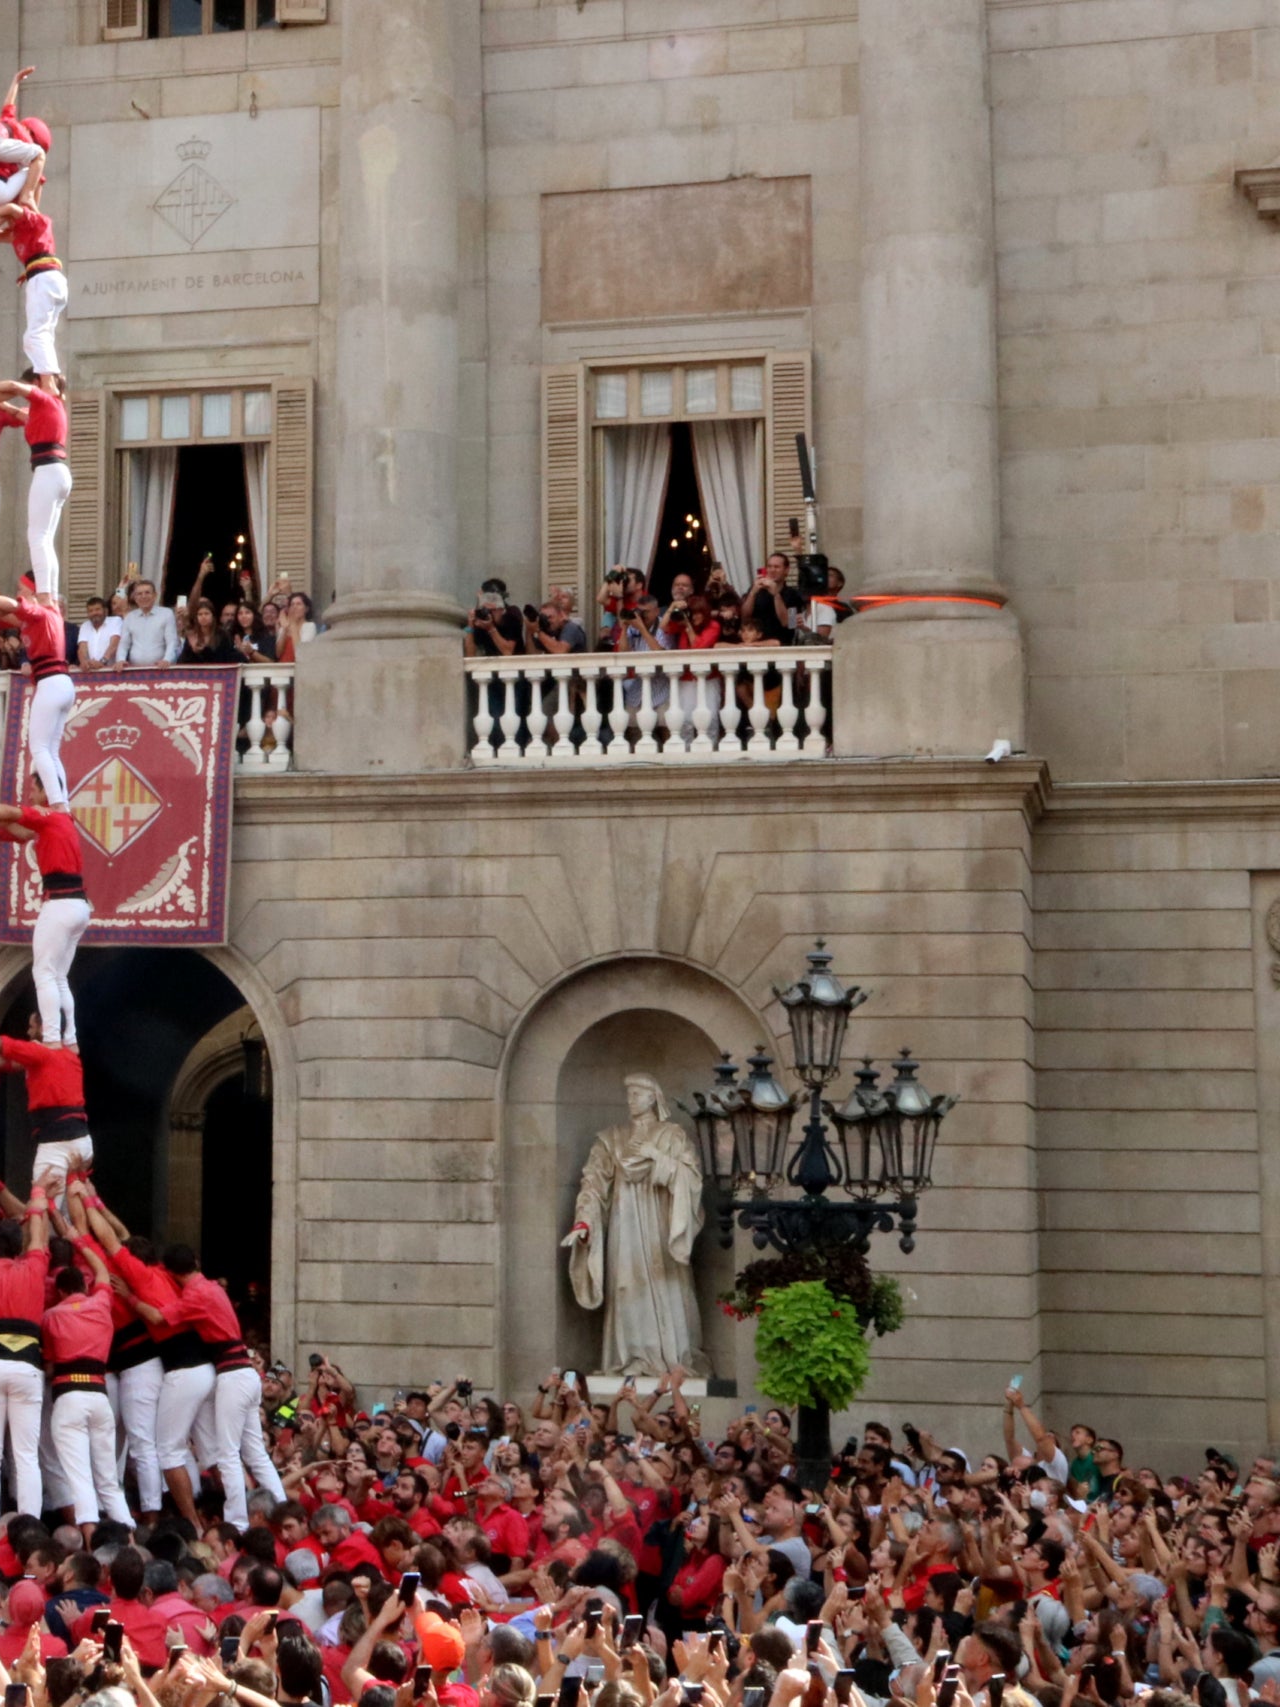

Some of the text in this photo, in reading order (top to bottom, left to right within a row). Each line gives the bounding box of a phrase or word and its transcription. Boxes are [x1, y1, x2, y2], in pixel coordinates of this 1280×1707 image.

[81, 270, 305, 296] AJUNTAMENT DE BARCELONA
